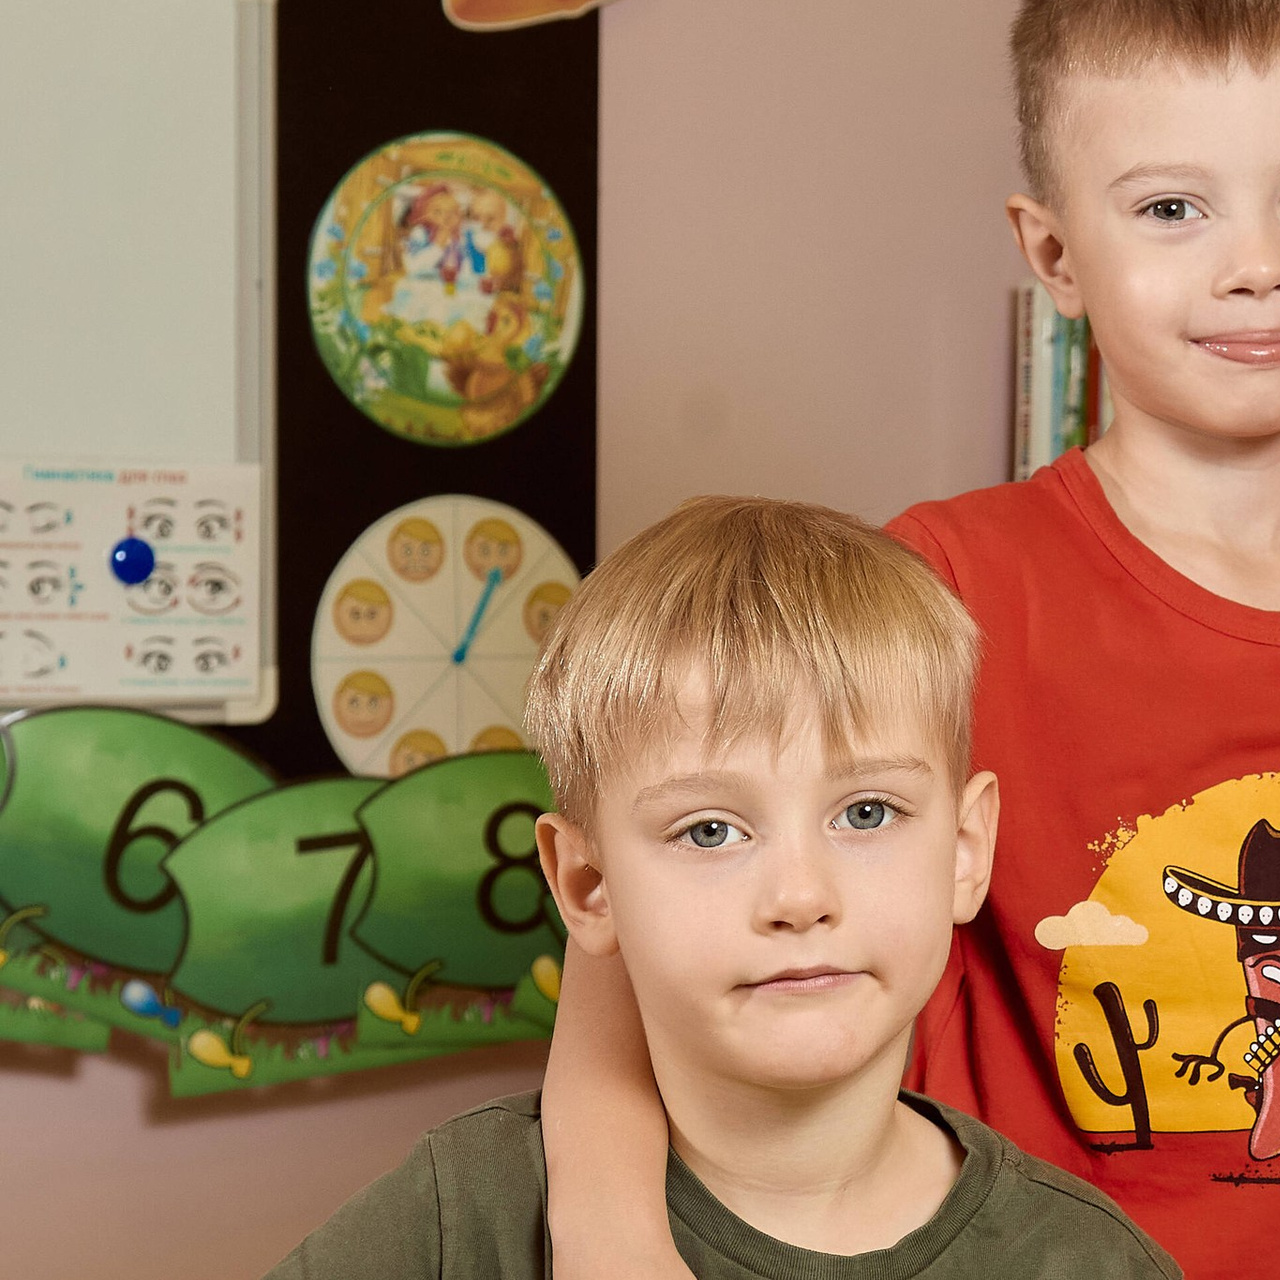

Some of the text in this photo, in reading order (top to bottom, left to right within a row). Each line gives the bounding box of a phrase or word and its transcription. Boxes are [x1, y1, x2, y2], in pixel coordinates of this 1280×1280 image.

[104, 779, 204, 913] 6
[296, 831, 372, 965] 7
[478, 802, 548, 934] 8
